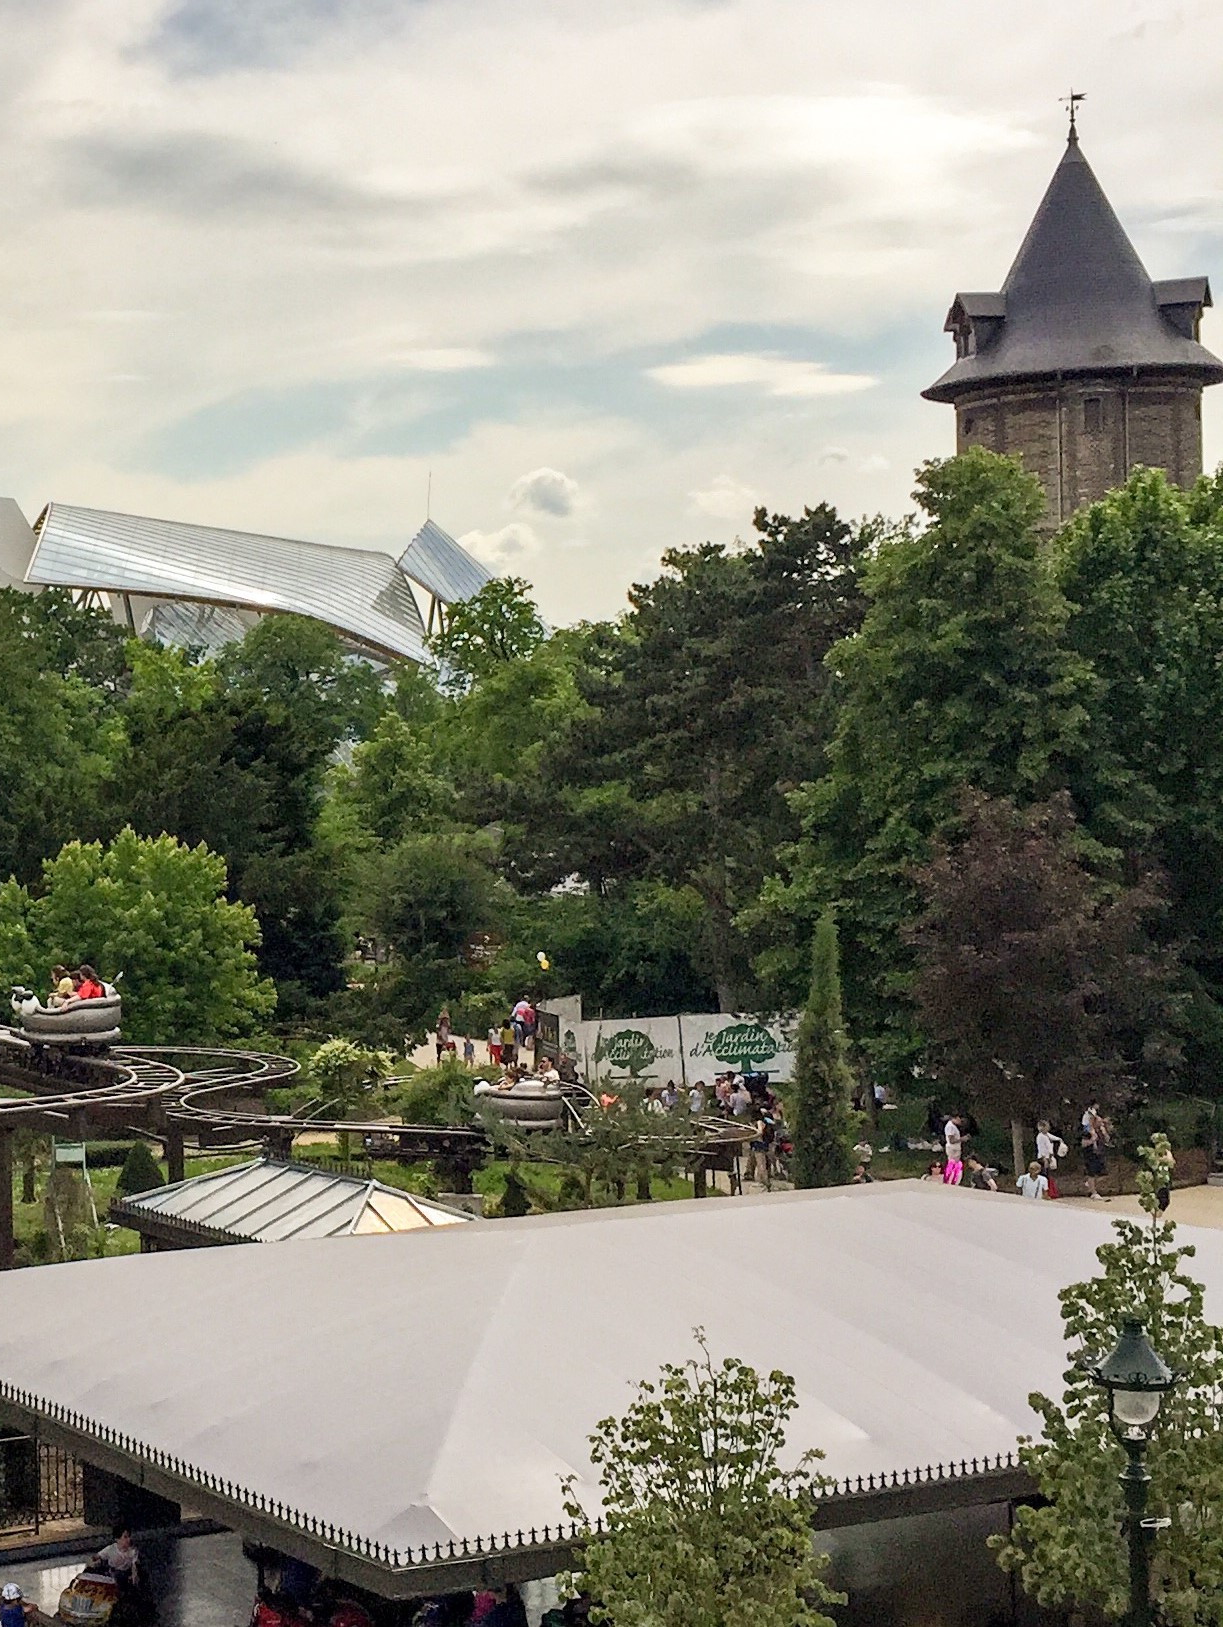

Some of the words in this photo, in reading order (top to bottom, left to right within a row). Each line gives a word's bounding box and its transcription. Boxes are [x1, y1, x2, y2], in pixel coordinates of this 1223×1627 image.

[703, 1031, 716, 1044] Le
[720, 1027, 768, 1045] Jardin
[689, 1041, 793, 1057] d'Acclimatatio
